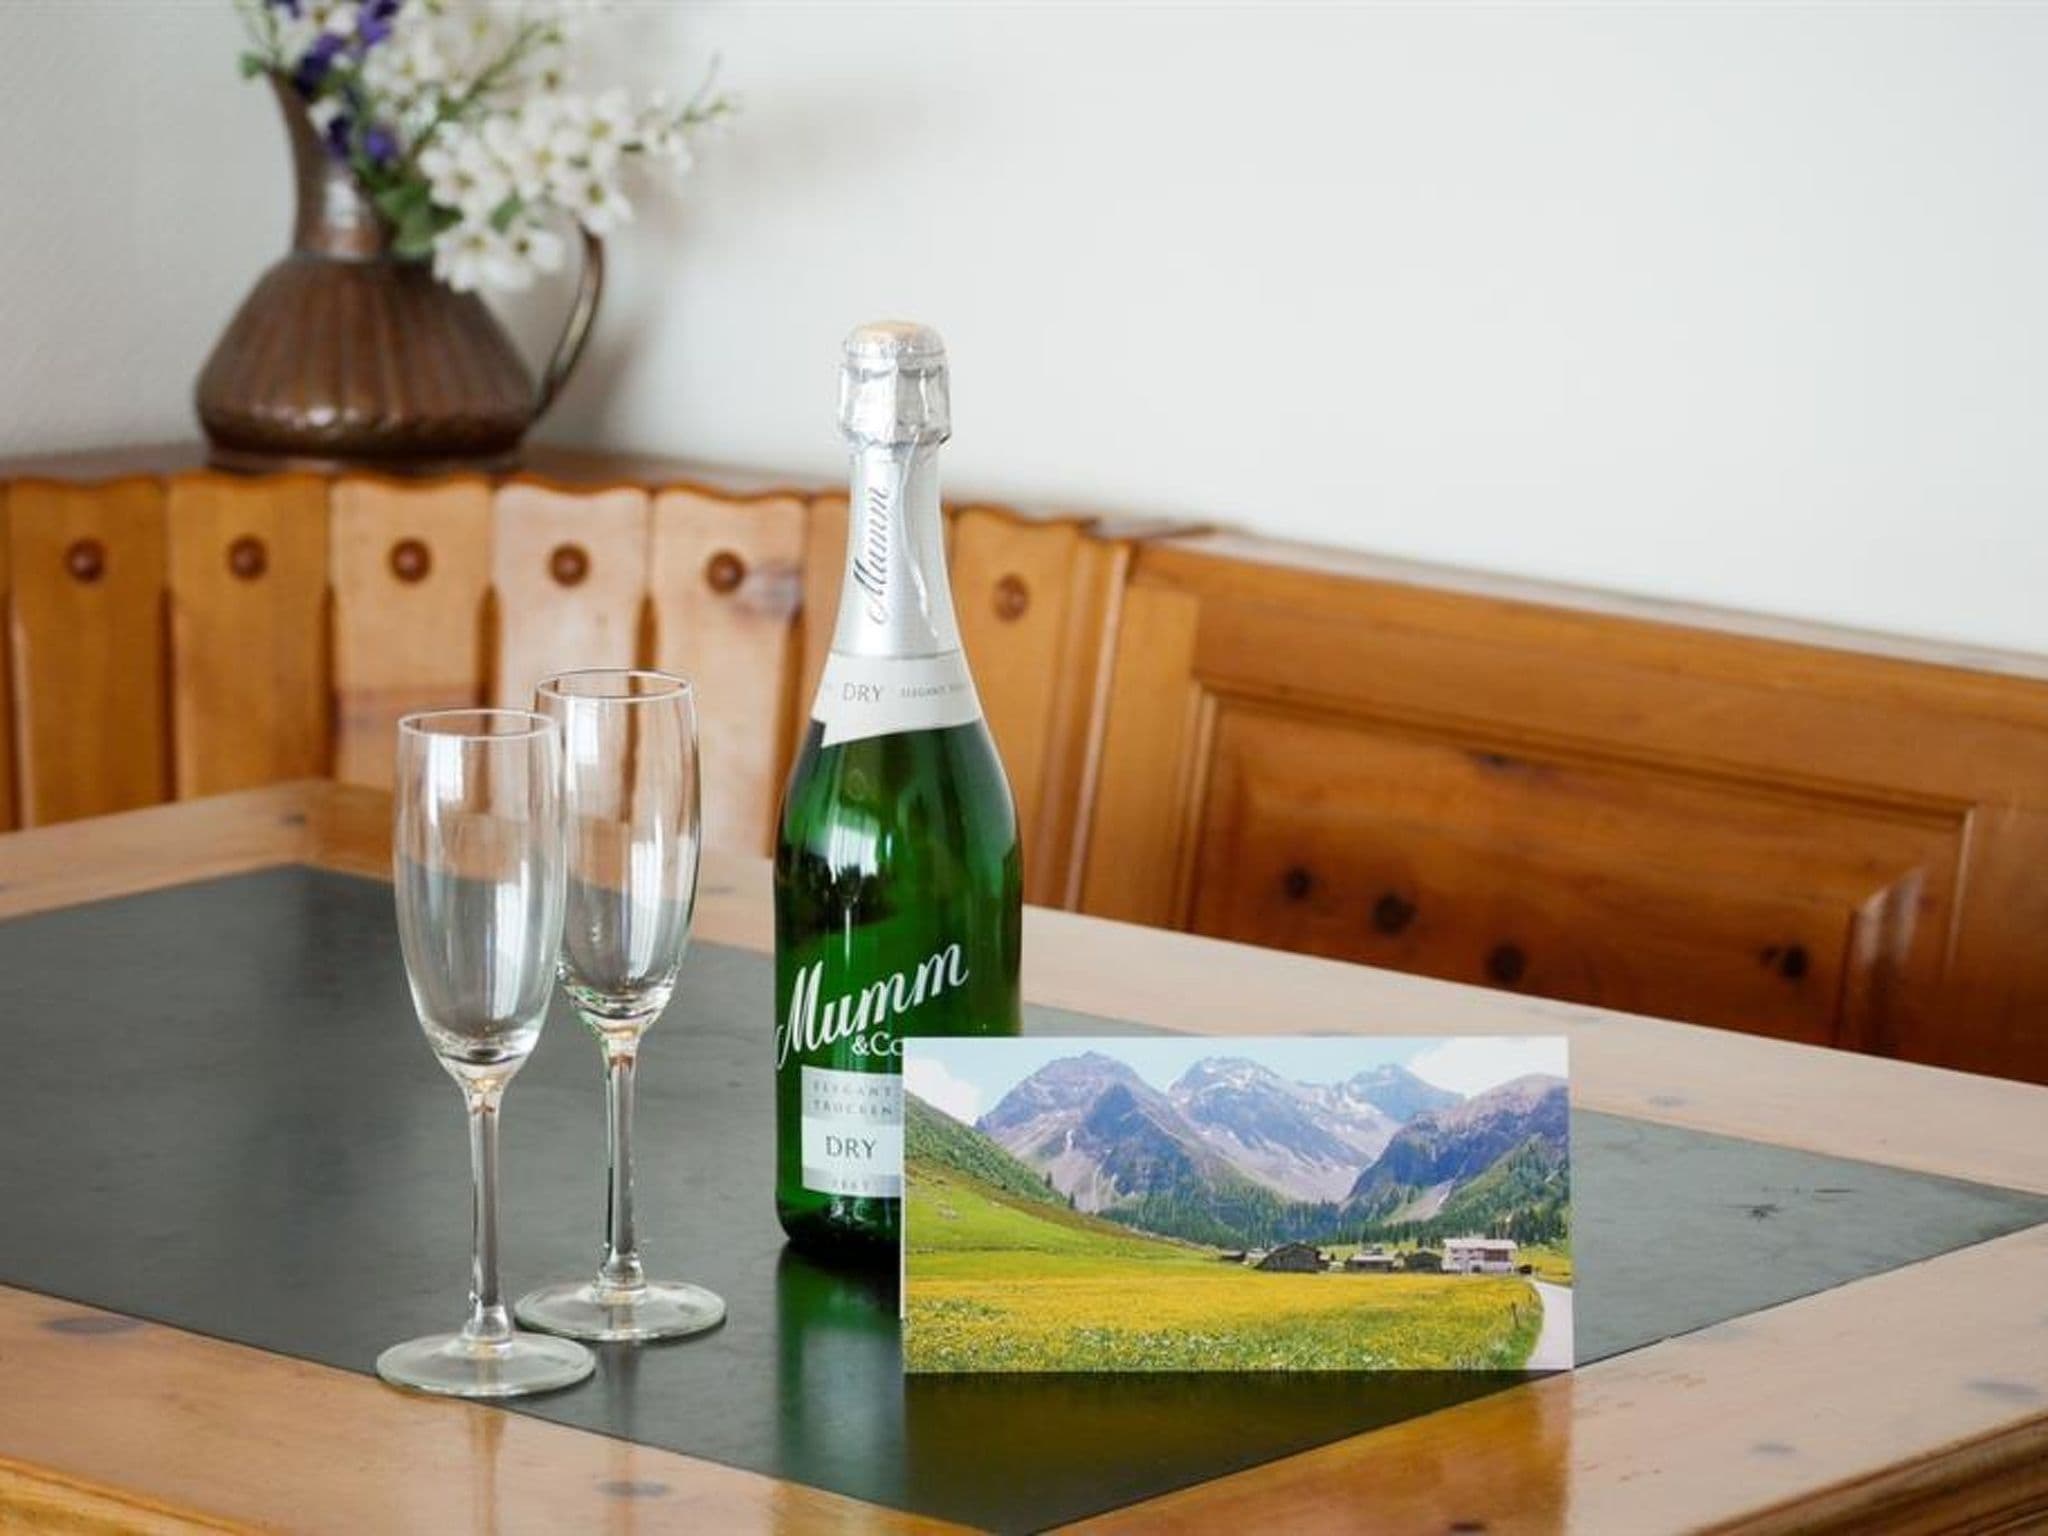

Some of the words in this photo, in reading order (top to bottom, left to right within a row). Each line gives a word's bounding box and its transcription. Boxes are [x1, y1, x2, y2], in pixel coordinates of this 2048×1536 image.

[853, 486, 890, 626] Mumm
[842, 681, 884, 702] DRY
[775, 943, 969, 1070] Mumm
[825, 1135, 877, 1160] DRY
